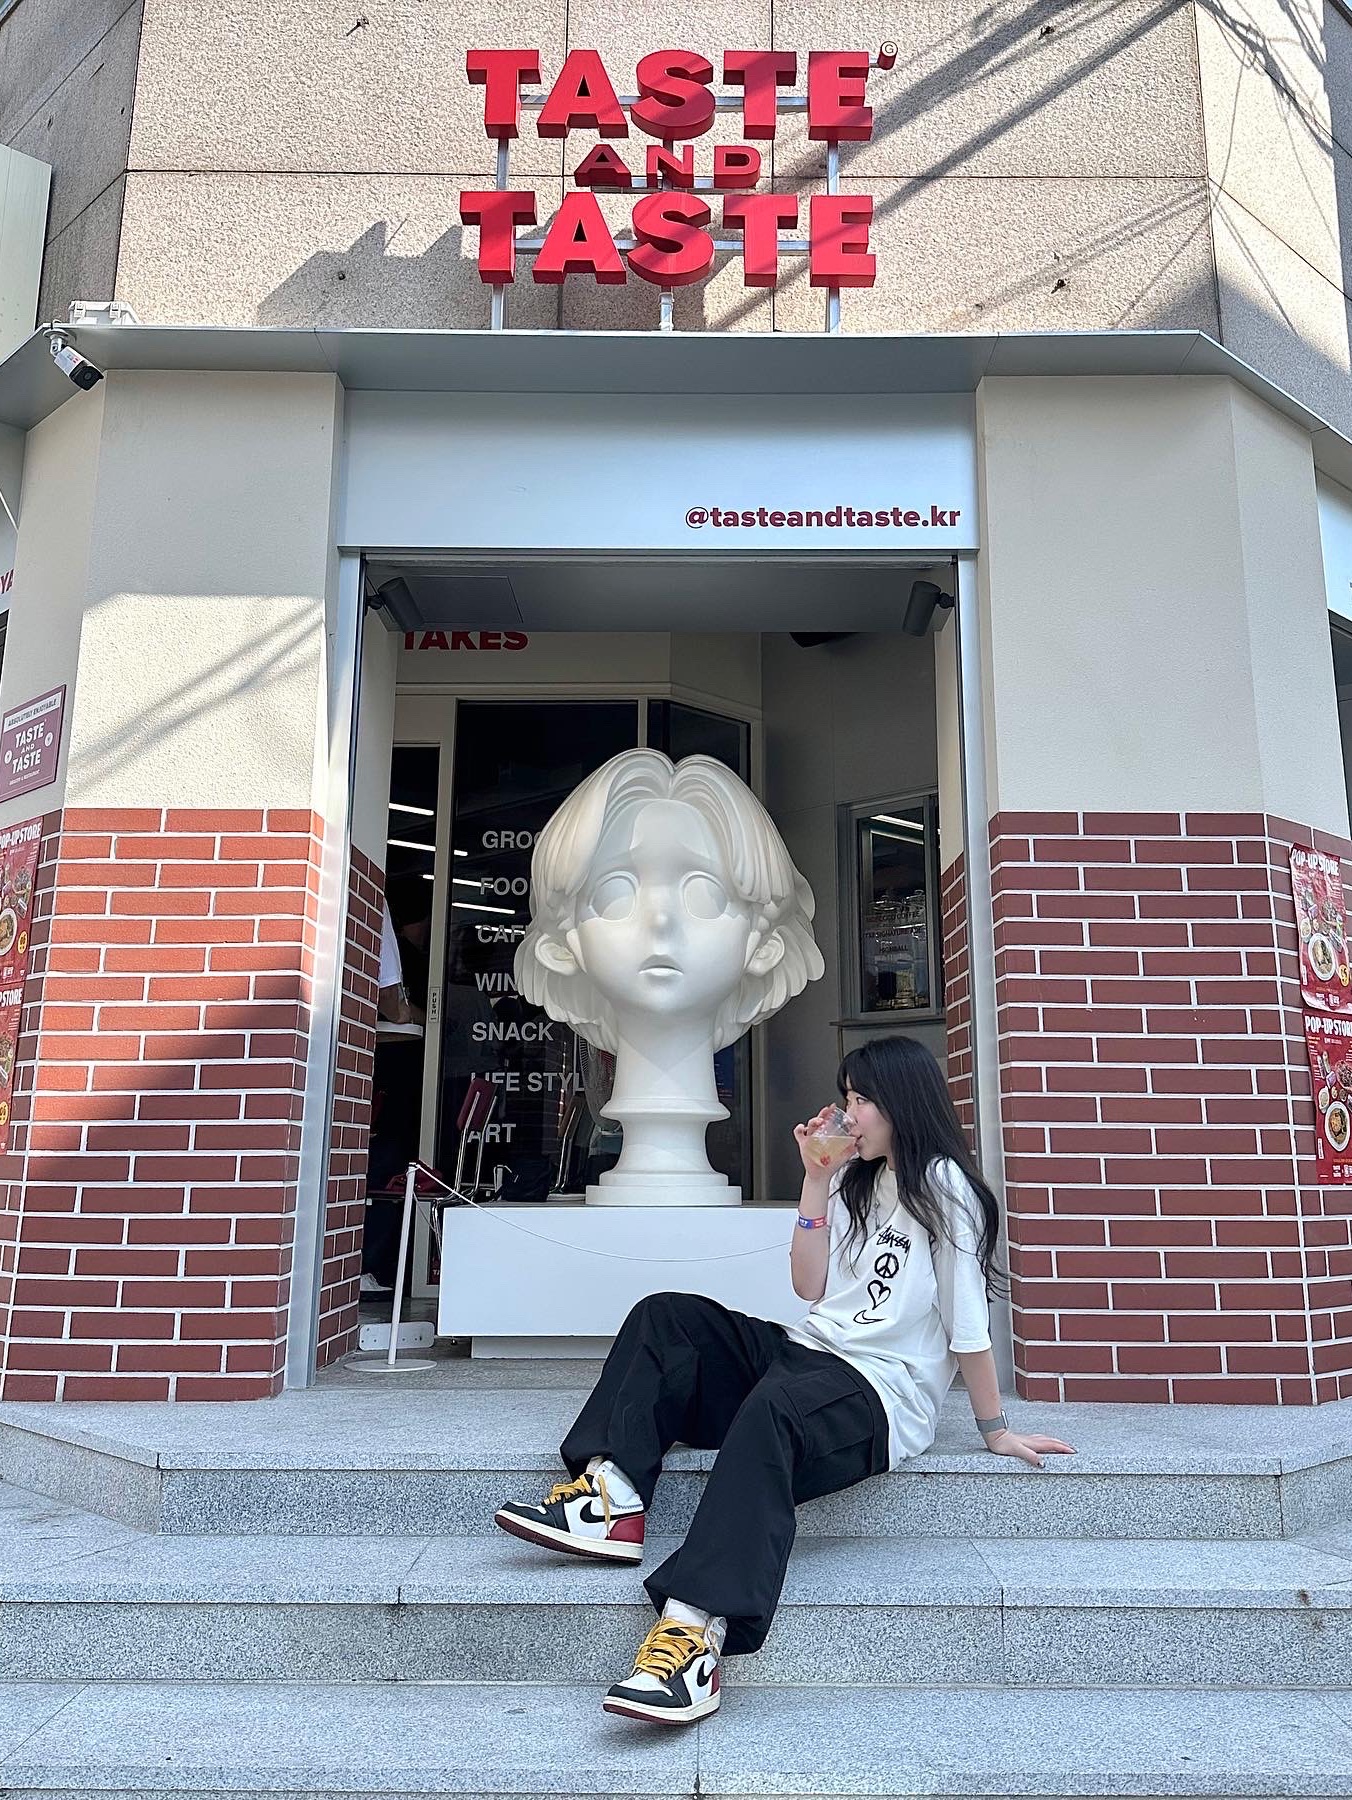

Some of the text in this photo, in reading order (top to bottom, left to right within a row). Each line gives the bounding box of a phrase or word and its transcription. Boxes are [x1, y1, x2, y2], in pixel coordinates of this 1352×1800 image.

[466, 49, 873, 141] TASTE
[574, 143, 762, 188] AND
[459, 190, 876, 288] TASTE
[685, 505, 960, 529] @tasteandtaste.kr
[15, 722, 45, 748] TASTE
[21, 743, 35, 754] AND
[12, 749, 42, 774] TASTE
[480, 877, 531, 896] FOO
[477, 925, 527, 943] CAF
[471, 1022, 554, 1041] SNACK
[527, 1072, 585, 1092] STYL
[467, 1123, 517, 1143] ART
